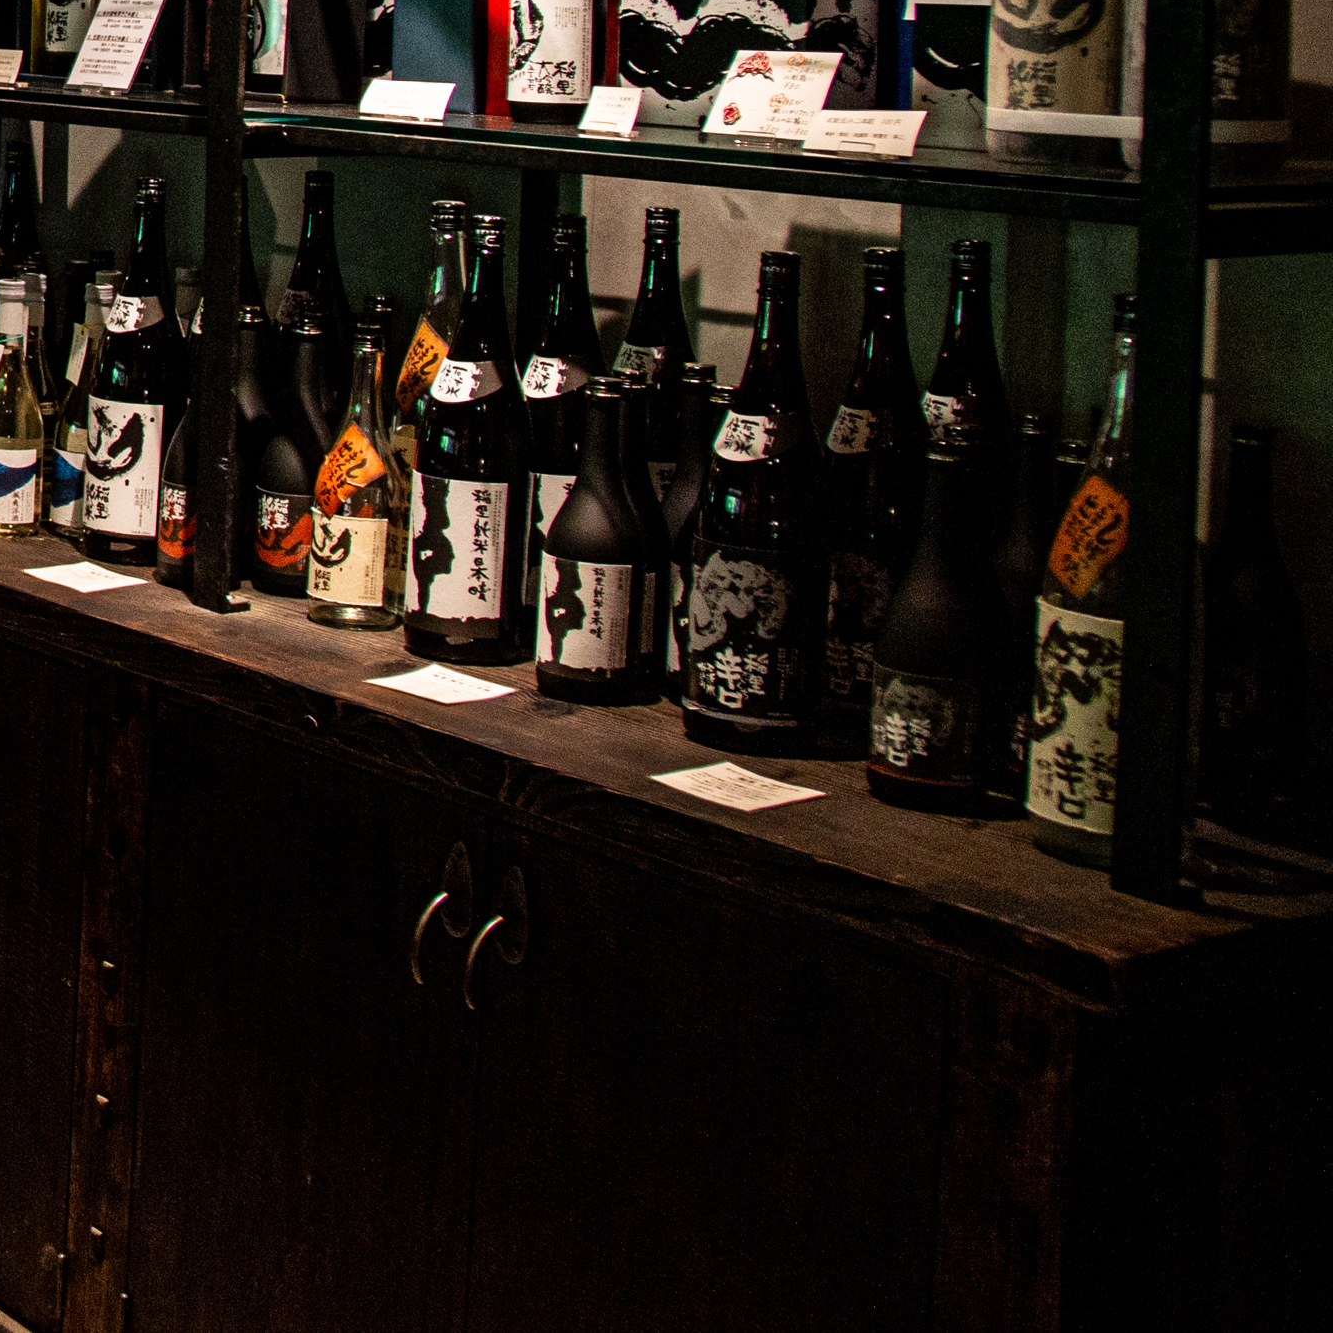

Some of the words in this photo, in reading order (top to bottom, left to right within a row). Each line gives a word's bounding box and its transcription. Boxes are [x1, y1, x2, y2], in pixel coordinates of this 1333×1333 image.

[552, 60, 578, 96] 稲里
[468, 488, 493, 603] 稲里純米日本晴
[714, 646, 743, 710] 辛口
[885, 712, 910, 768] 辛口
[1053, 742, 1087, 820] 辛口
